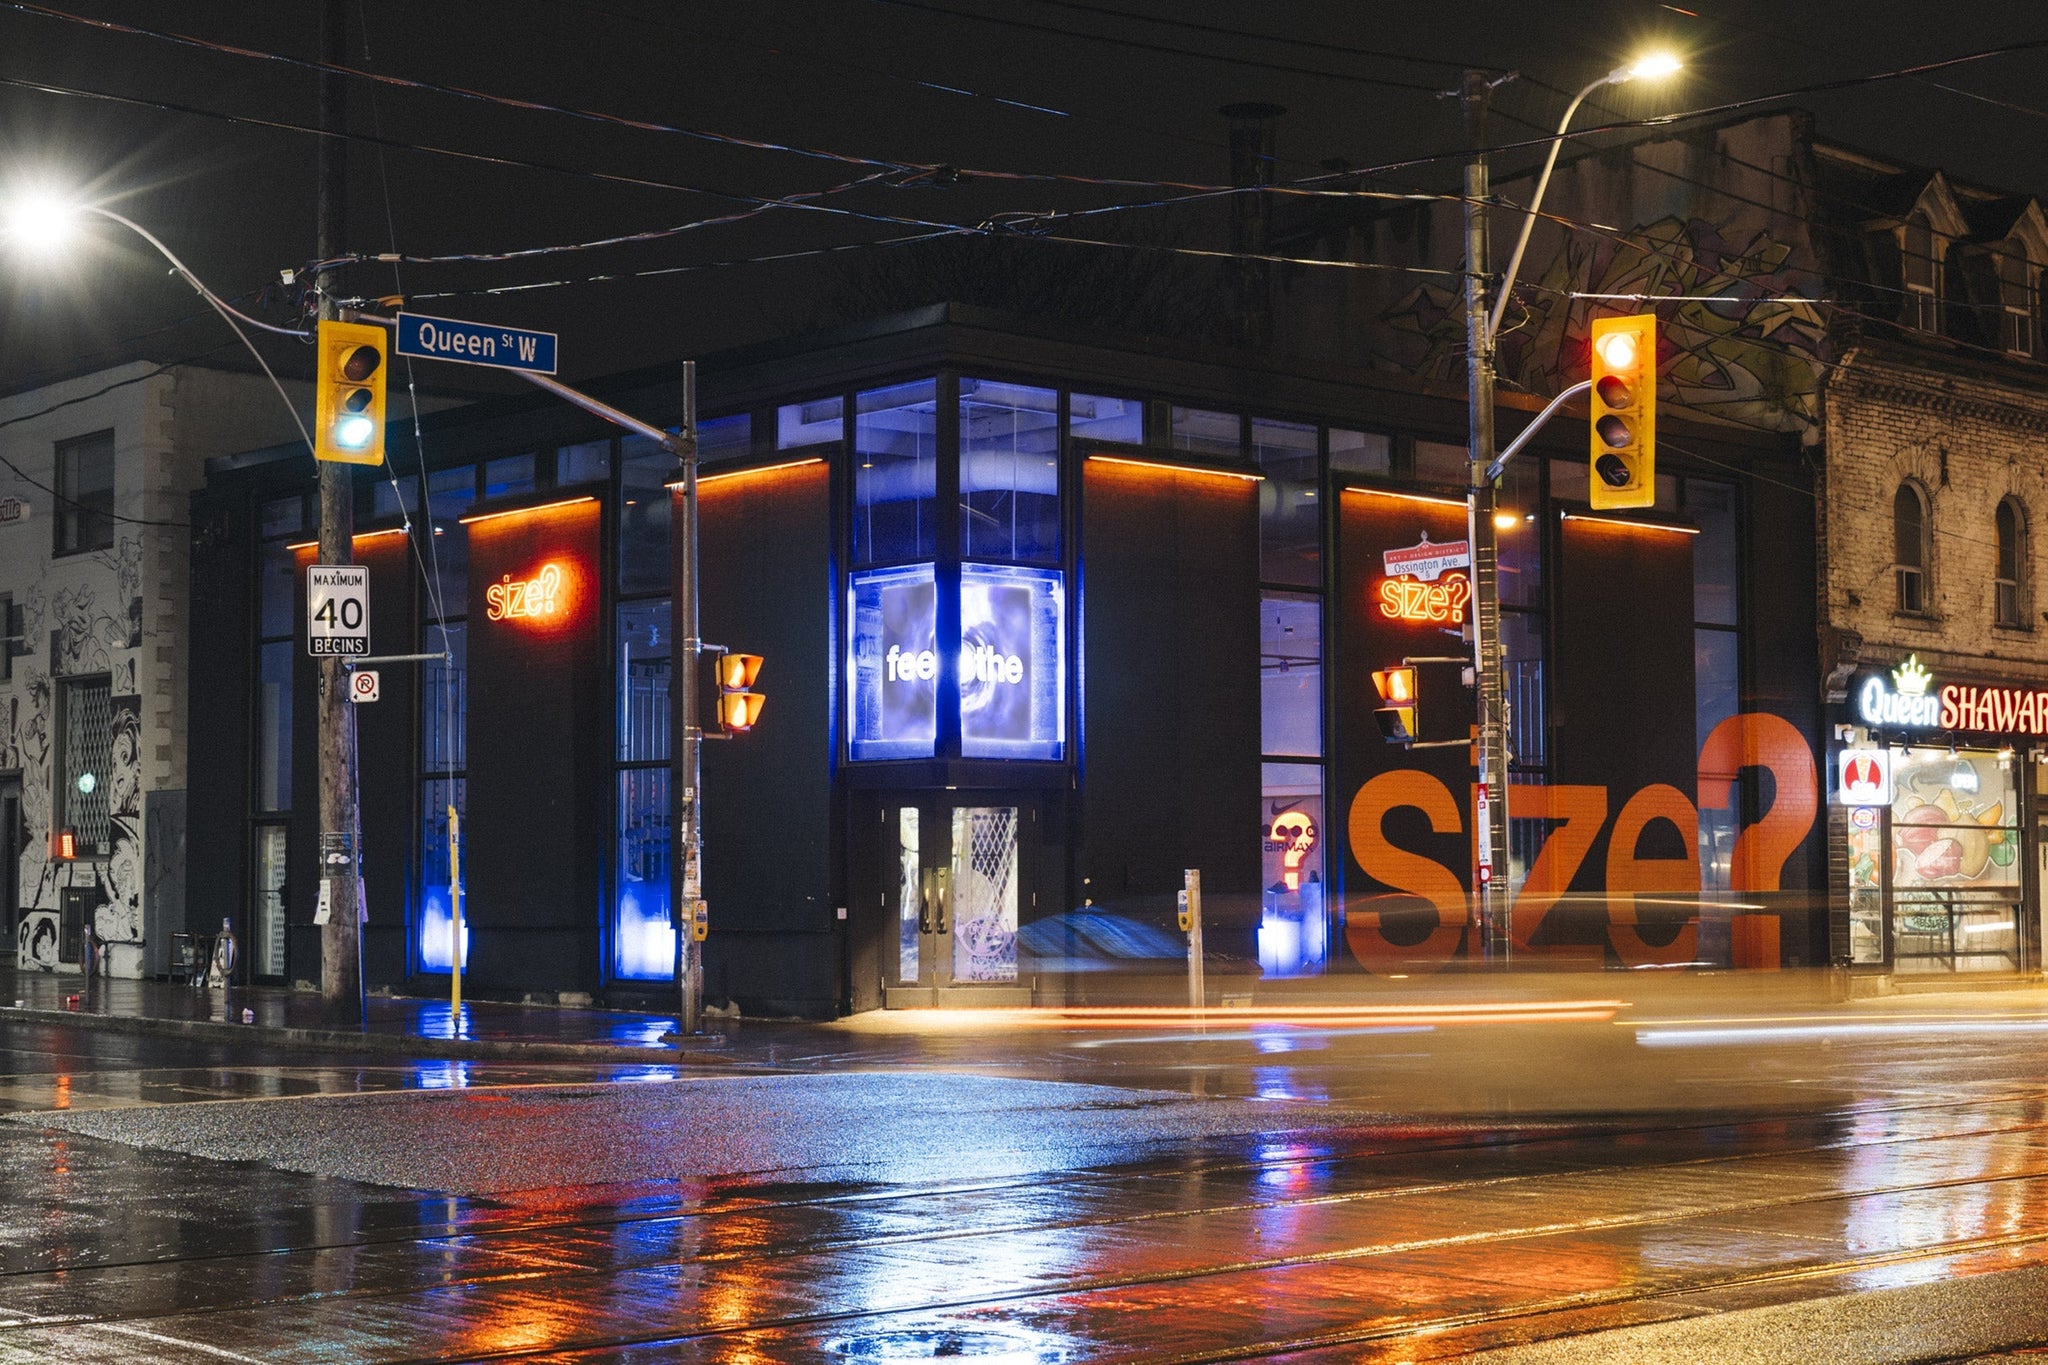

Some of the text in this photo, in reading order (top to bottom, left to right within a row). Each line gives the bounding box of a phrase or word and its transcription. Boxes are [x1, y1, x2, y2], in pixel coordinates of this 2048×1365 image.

[419, 322, 536, 362] Queen St W
[313, 574, 363, 586] MAXIMUM
[1394, 561, 1438, 573] Ossington
[486, 563, 561, 621] size?
[1380, 574, 1471, 622] size?
[314, 597, 363, 630] 40
[314, 638, 364, 653] BEGINS
[974, 645, 1023, 684] the
[1862, 677, 1939, 725] Queen
[1345, 713, 1818, 978] sze?
